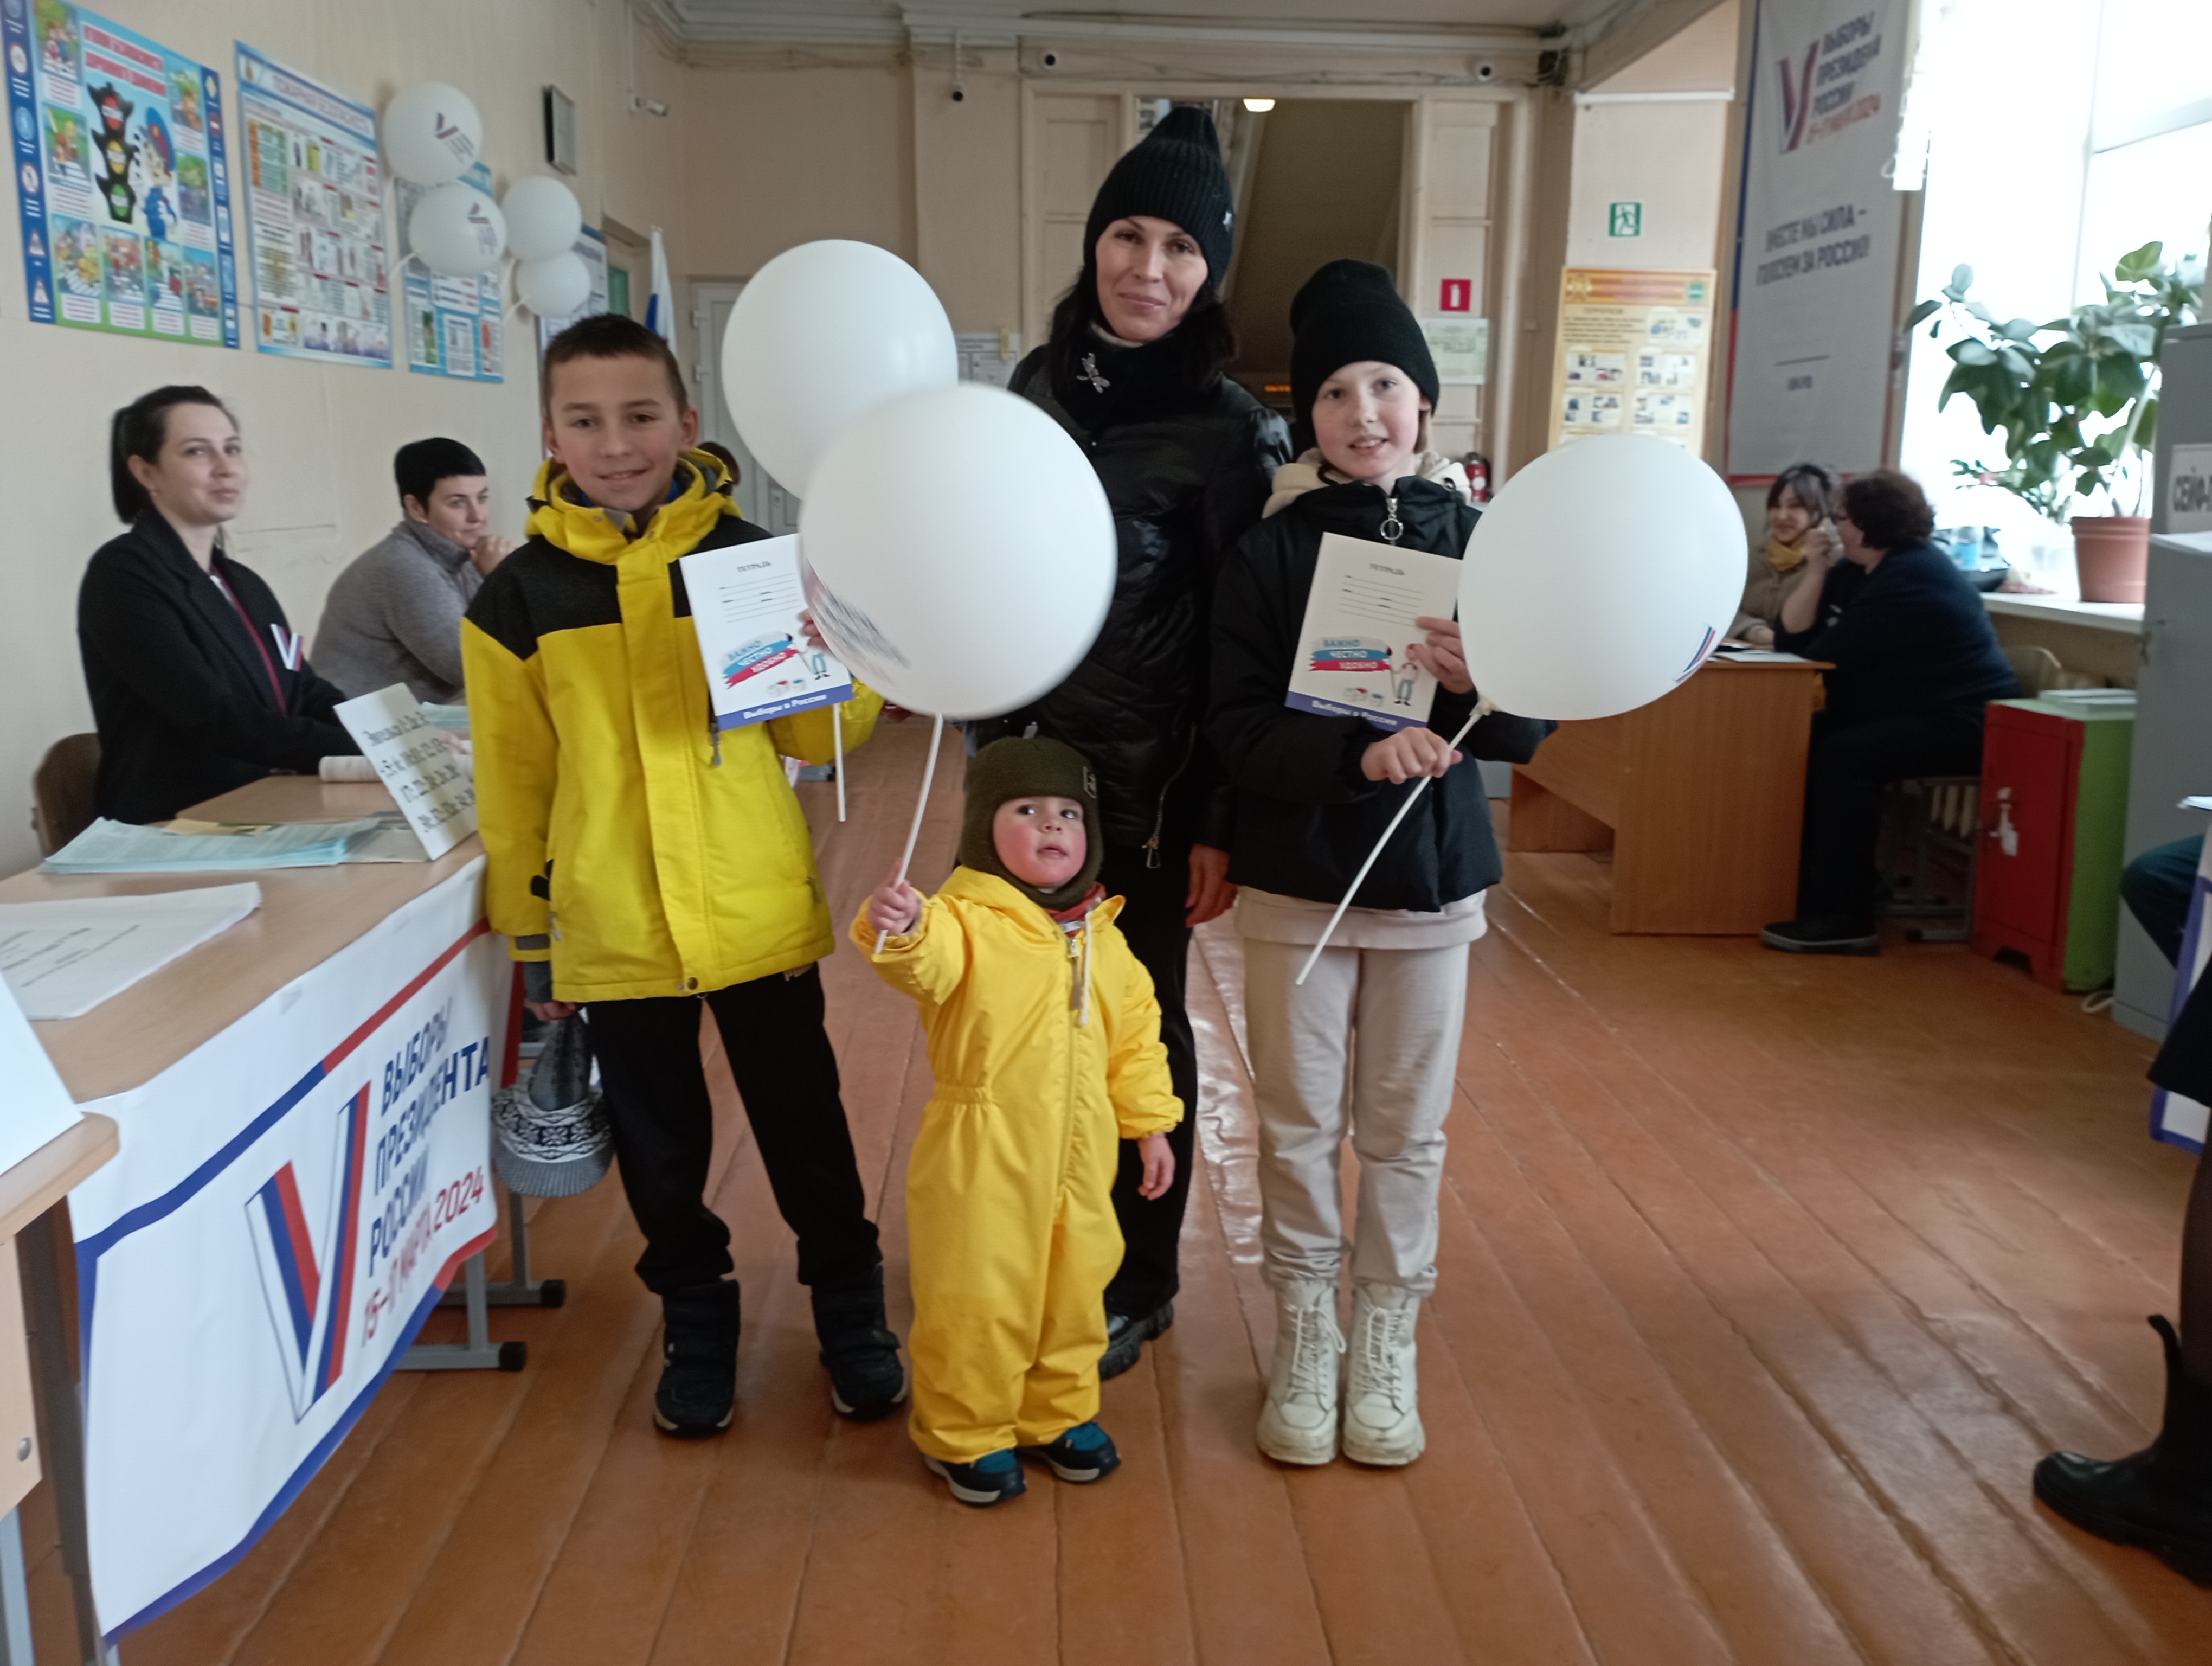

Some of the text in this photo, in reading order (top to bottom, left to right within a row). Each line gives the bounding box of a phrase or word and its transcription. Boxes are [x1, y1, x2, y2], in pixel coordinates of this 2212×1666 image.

[1324, 639, 1360, 648] ВАЖНО
[1330, 650, 1368, 658] ЧЕСТНО
[743, 703, 783, 719] Выборы
[791, 694, 827, 707] России
[1311, 700, 1351, 715] Выборы
[381, 996, 453, 1117] ВЫБОРЫ
[375, 1035, 490, 1197] ПРЕЗИДЕНТА
[368, 1143, 430, 1278] РОССИИ
[433, 1165, 485, 1233] 2024
